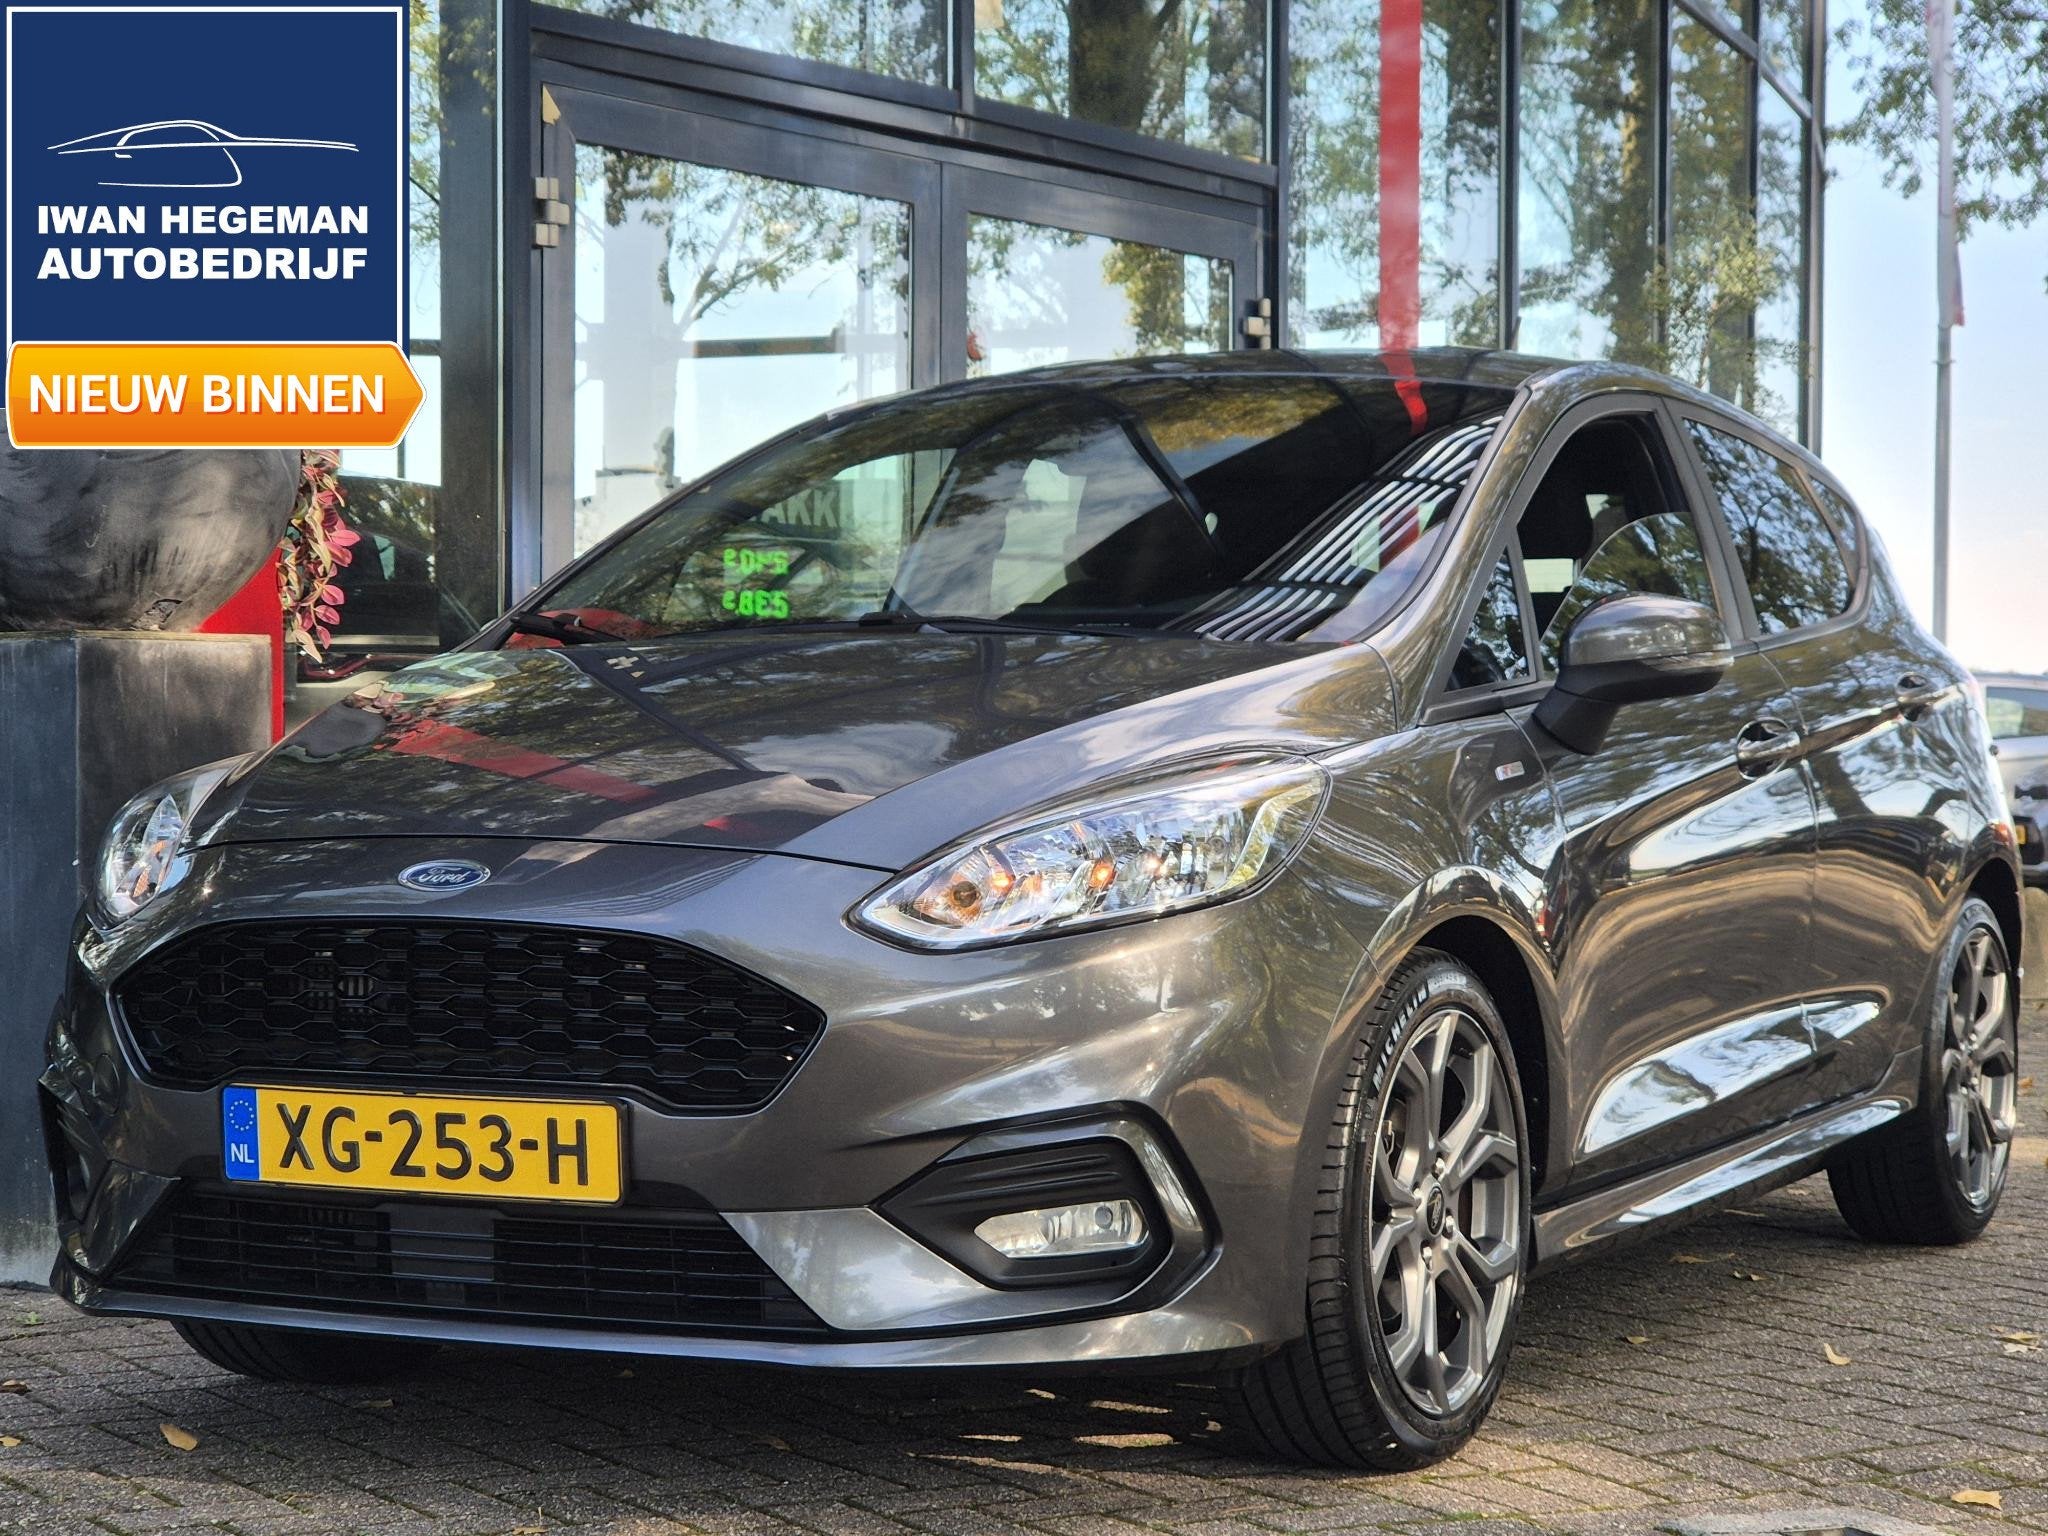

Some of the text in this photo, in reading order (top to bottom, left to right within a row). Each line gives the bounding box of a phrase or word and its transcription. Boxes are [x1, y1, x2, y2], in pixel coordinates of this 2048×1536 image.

[418, 866, 470, 884] Ford
[1372, 980, 1430, 1091] MICHELIN
[231, 1143, 254, 1164] NL
[275, 1102, 590, 1187] XG-253-H
